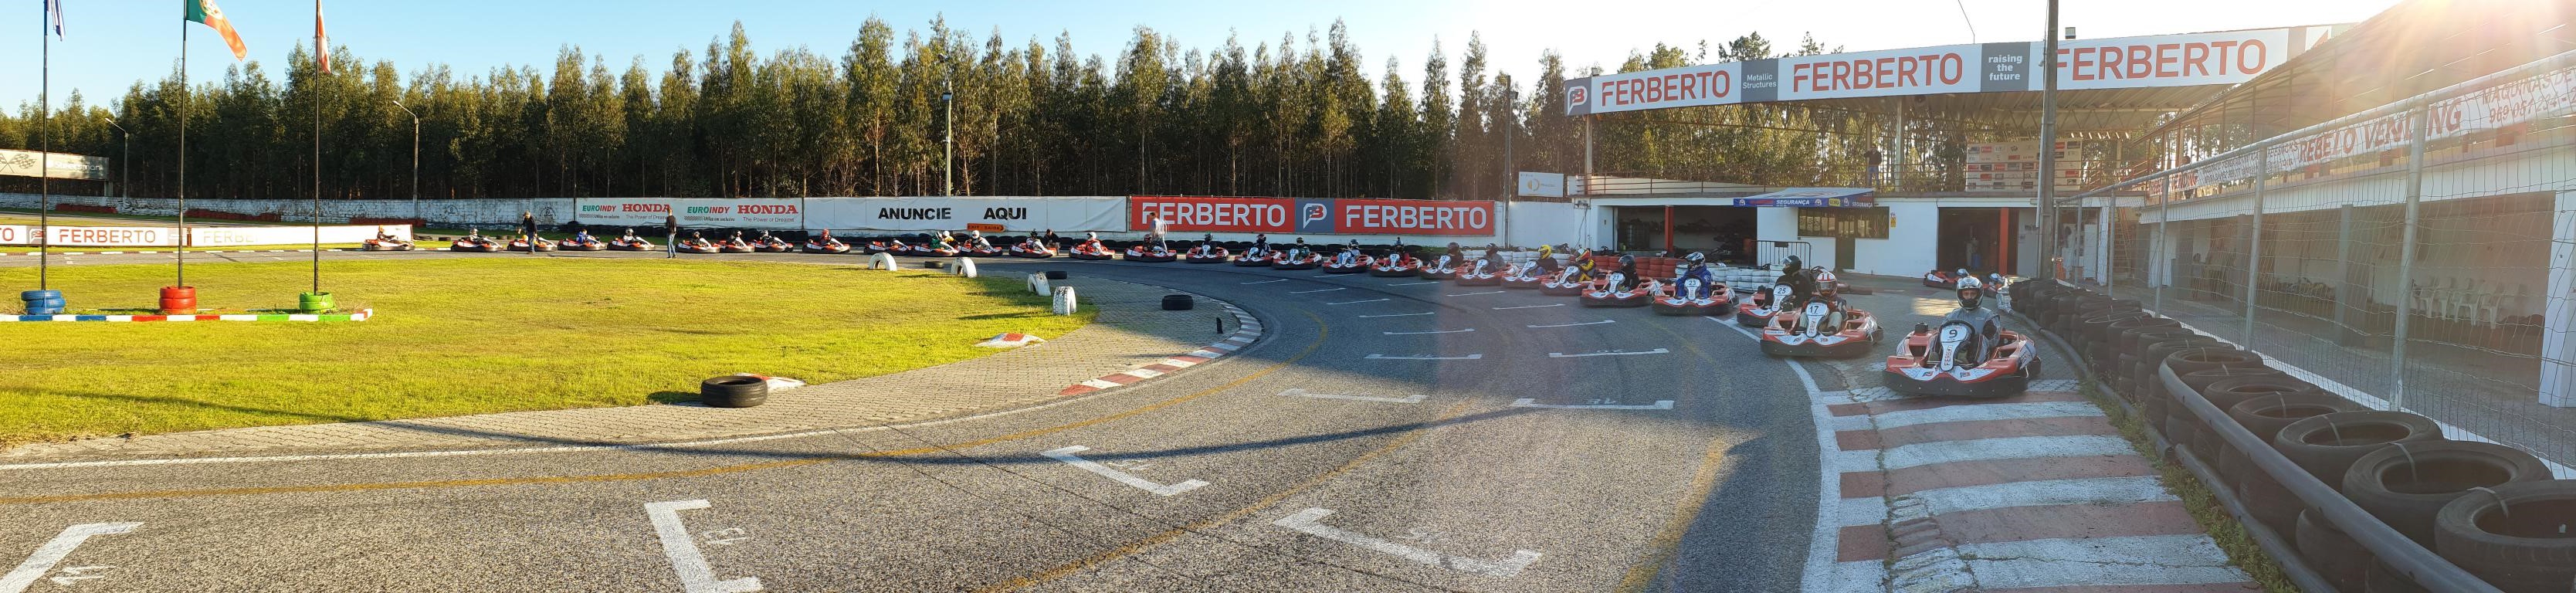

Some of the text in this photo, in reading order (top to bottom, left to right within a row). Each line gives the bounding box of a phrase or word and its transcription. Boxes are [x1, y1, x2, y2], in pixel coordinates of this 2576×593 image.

[1988, 54, 2022, 70] raising
[2057, 39, 2266, 82] FERBERTO
[1793, 53, 1963, 93] FERBERTO
[1997, 63, 2013, 73] the
[1989, 72, 2021, 81] future
[1602, 69, 1730, 107] FERBERTO
[1742, 80, 1777, 90] Structures
[2363, 97, 2462, 149] VENNG
[737, 205, 798, 214] HONDA
[878, 207, 1027, 221] ANUNCIE AQUI
[1141, 202, 1286, 228] FERBERTO
[1346, 204, 1487, 230] FERBERTO
[59, 229, 156, 243] FERBERTO
[1809, 305, 1819, 313] 17
[1948, 329, 1958, 339] 9
